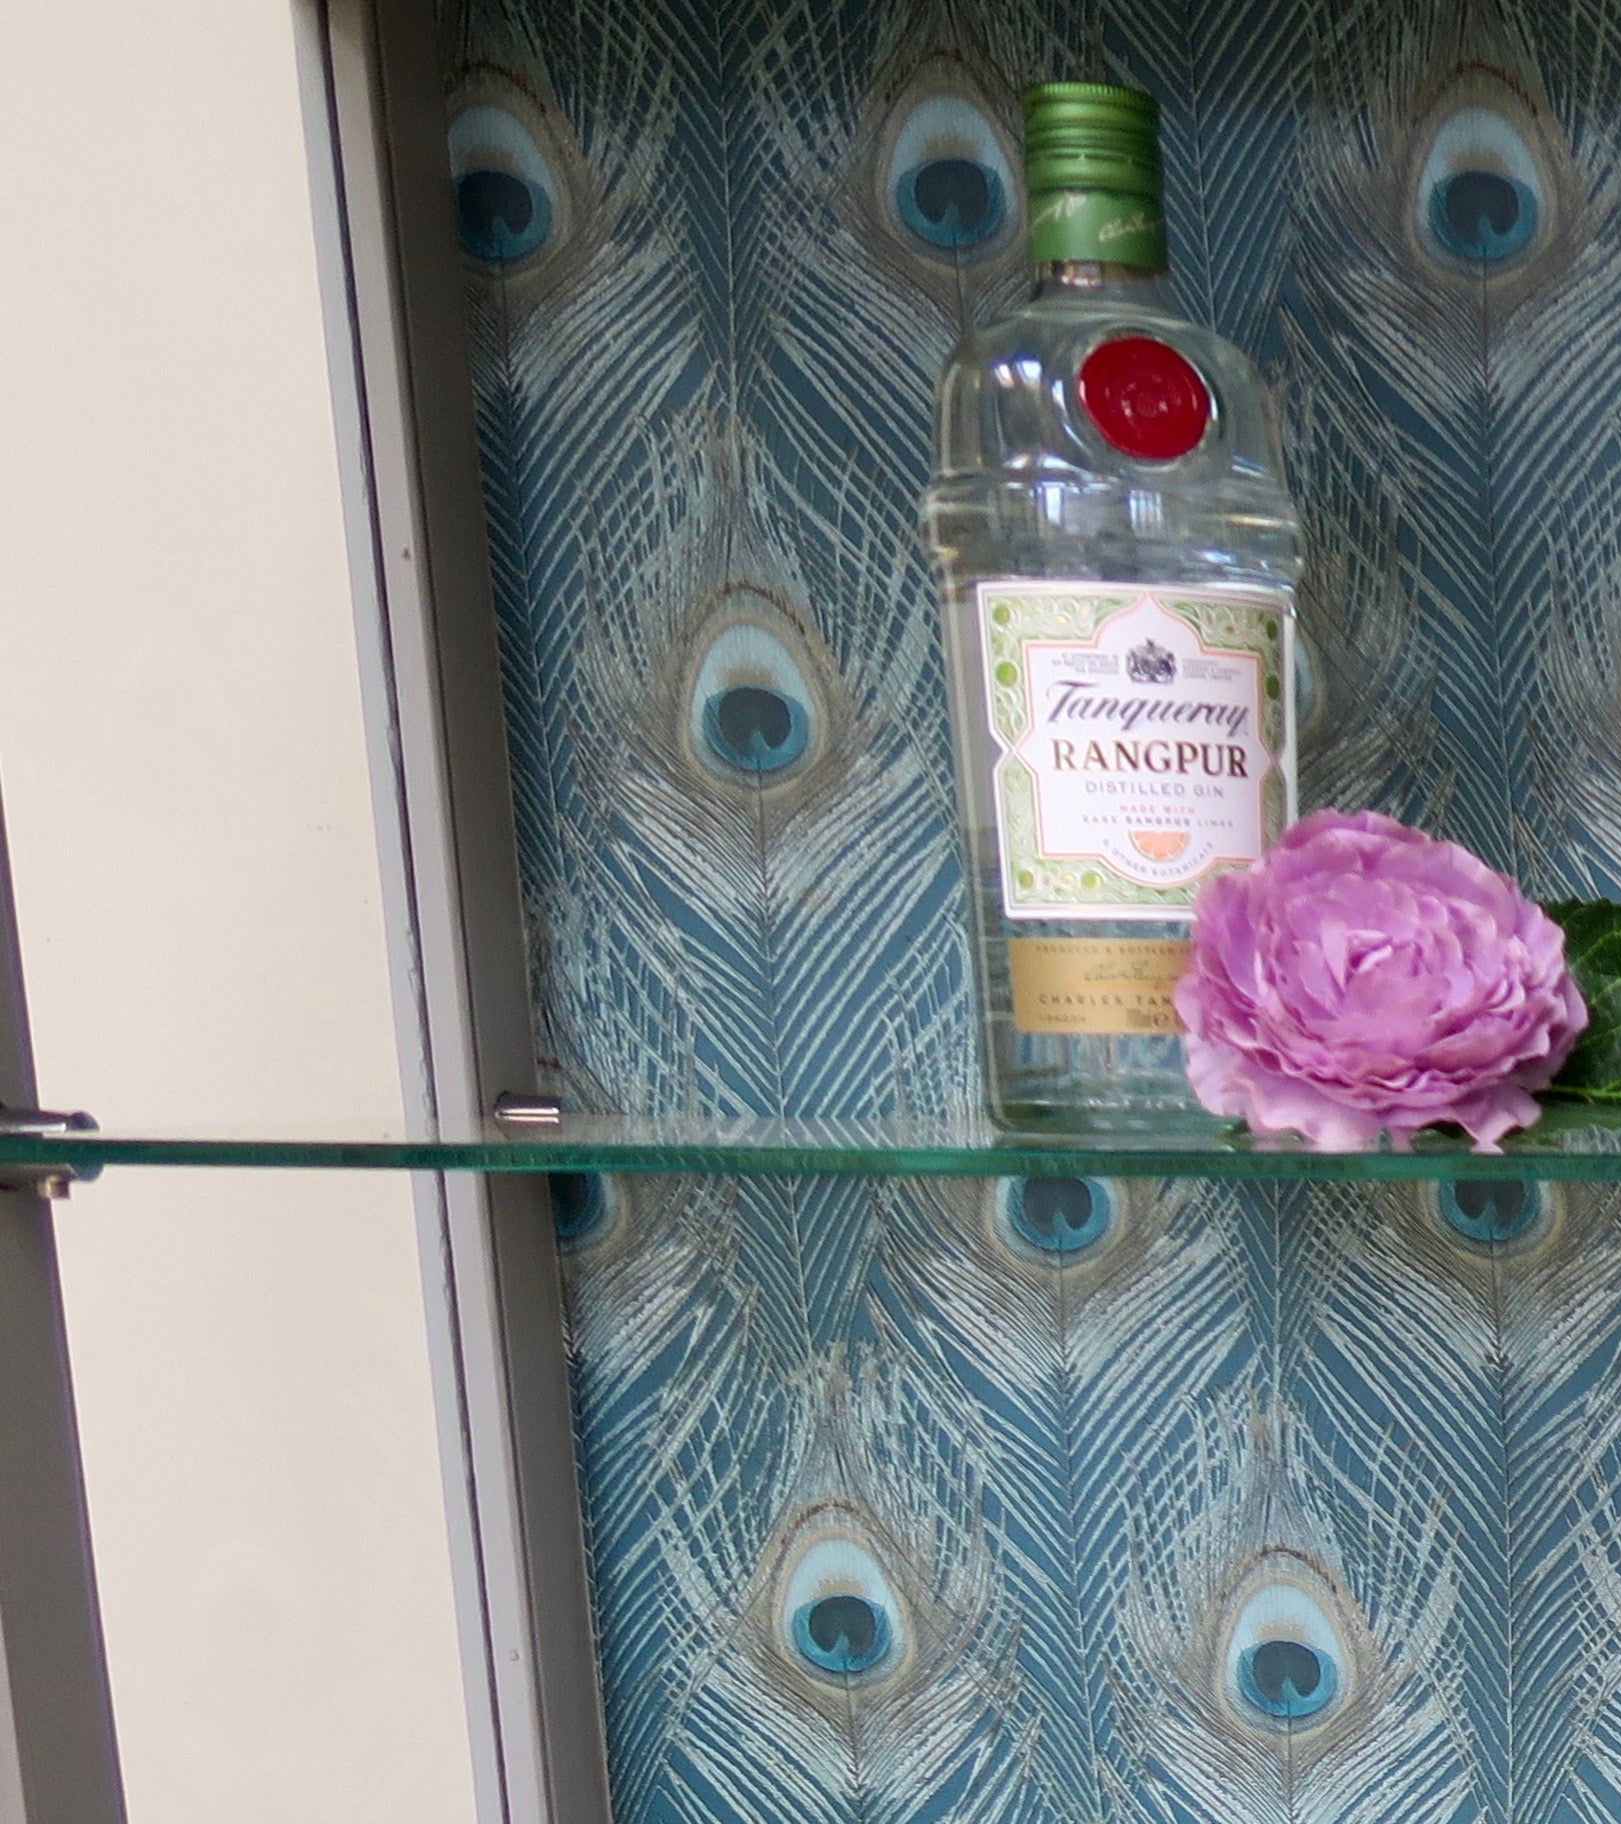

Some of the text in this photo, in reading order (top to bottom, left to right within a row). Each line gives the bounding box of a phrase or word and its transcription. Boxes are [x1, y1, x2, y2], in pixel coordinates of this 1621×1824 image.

[1046, 680, 1249, 737] Tanqueray
[1051, 739, 1248, 778] RANGPUR
[1085, 780, 1224, 798] DISTILLED GIN
